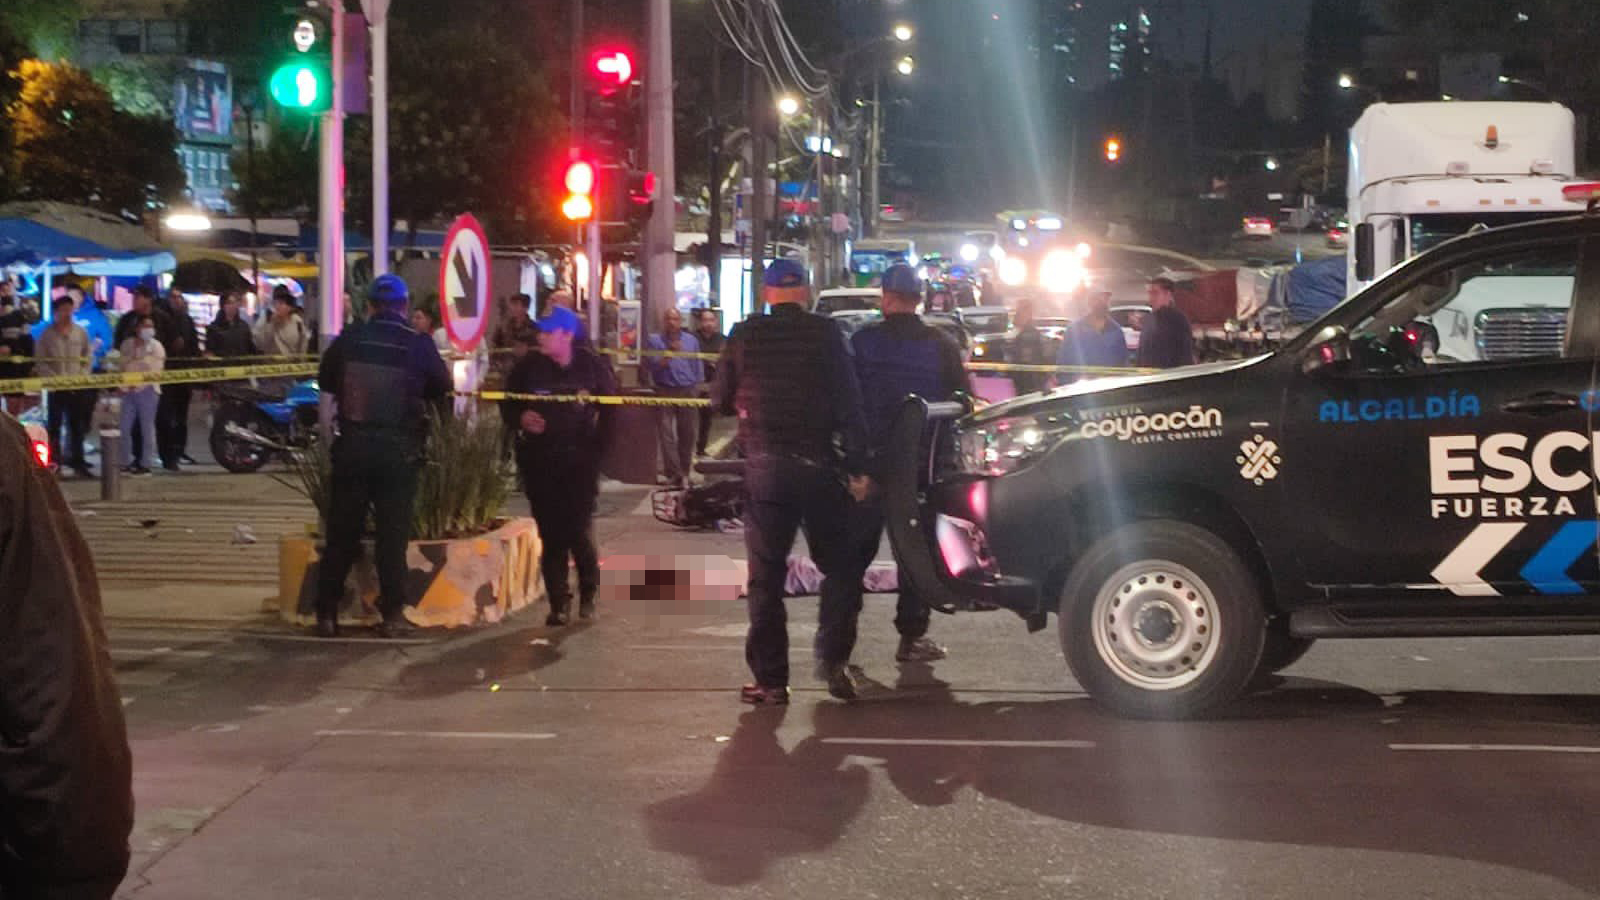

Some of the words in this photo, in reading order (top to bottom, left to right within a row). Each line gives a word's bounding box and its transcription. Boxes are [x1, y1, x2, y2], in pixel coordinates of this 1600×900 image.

[1319, 388, 1480, 422] ALCALDÍA
[1429, 431, 1600, 494] ESC
[1431, 496, 1576, 518] FUERZA
